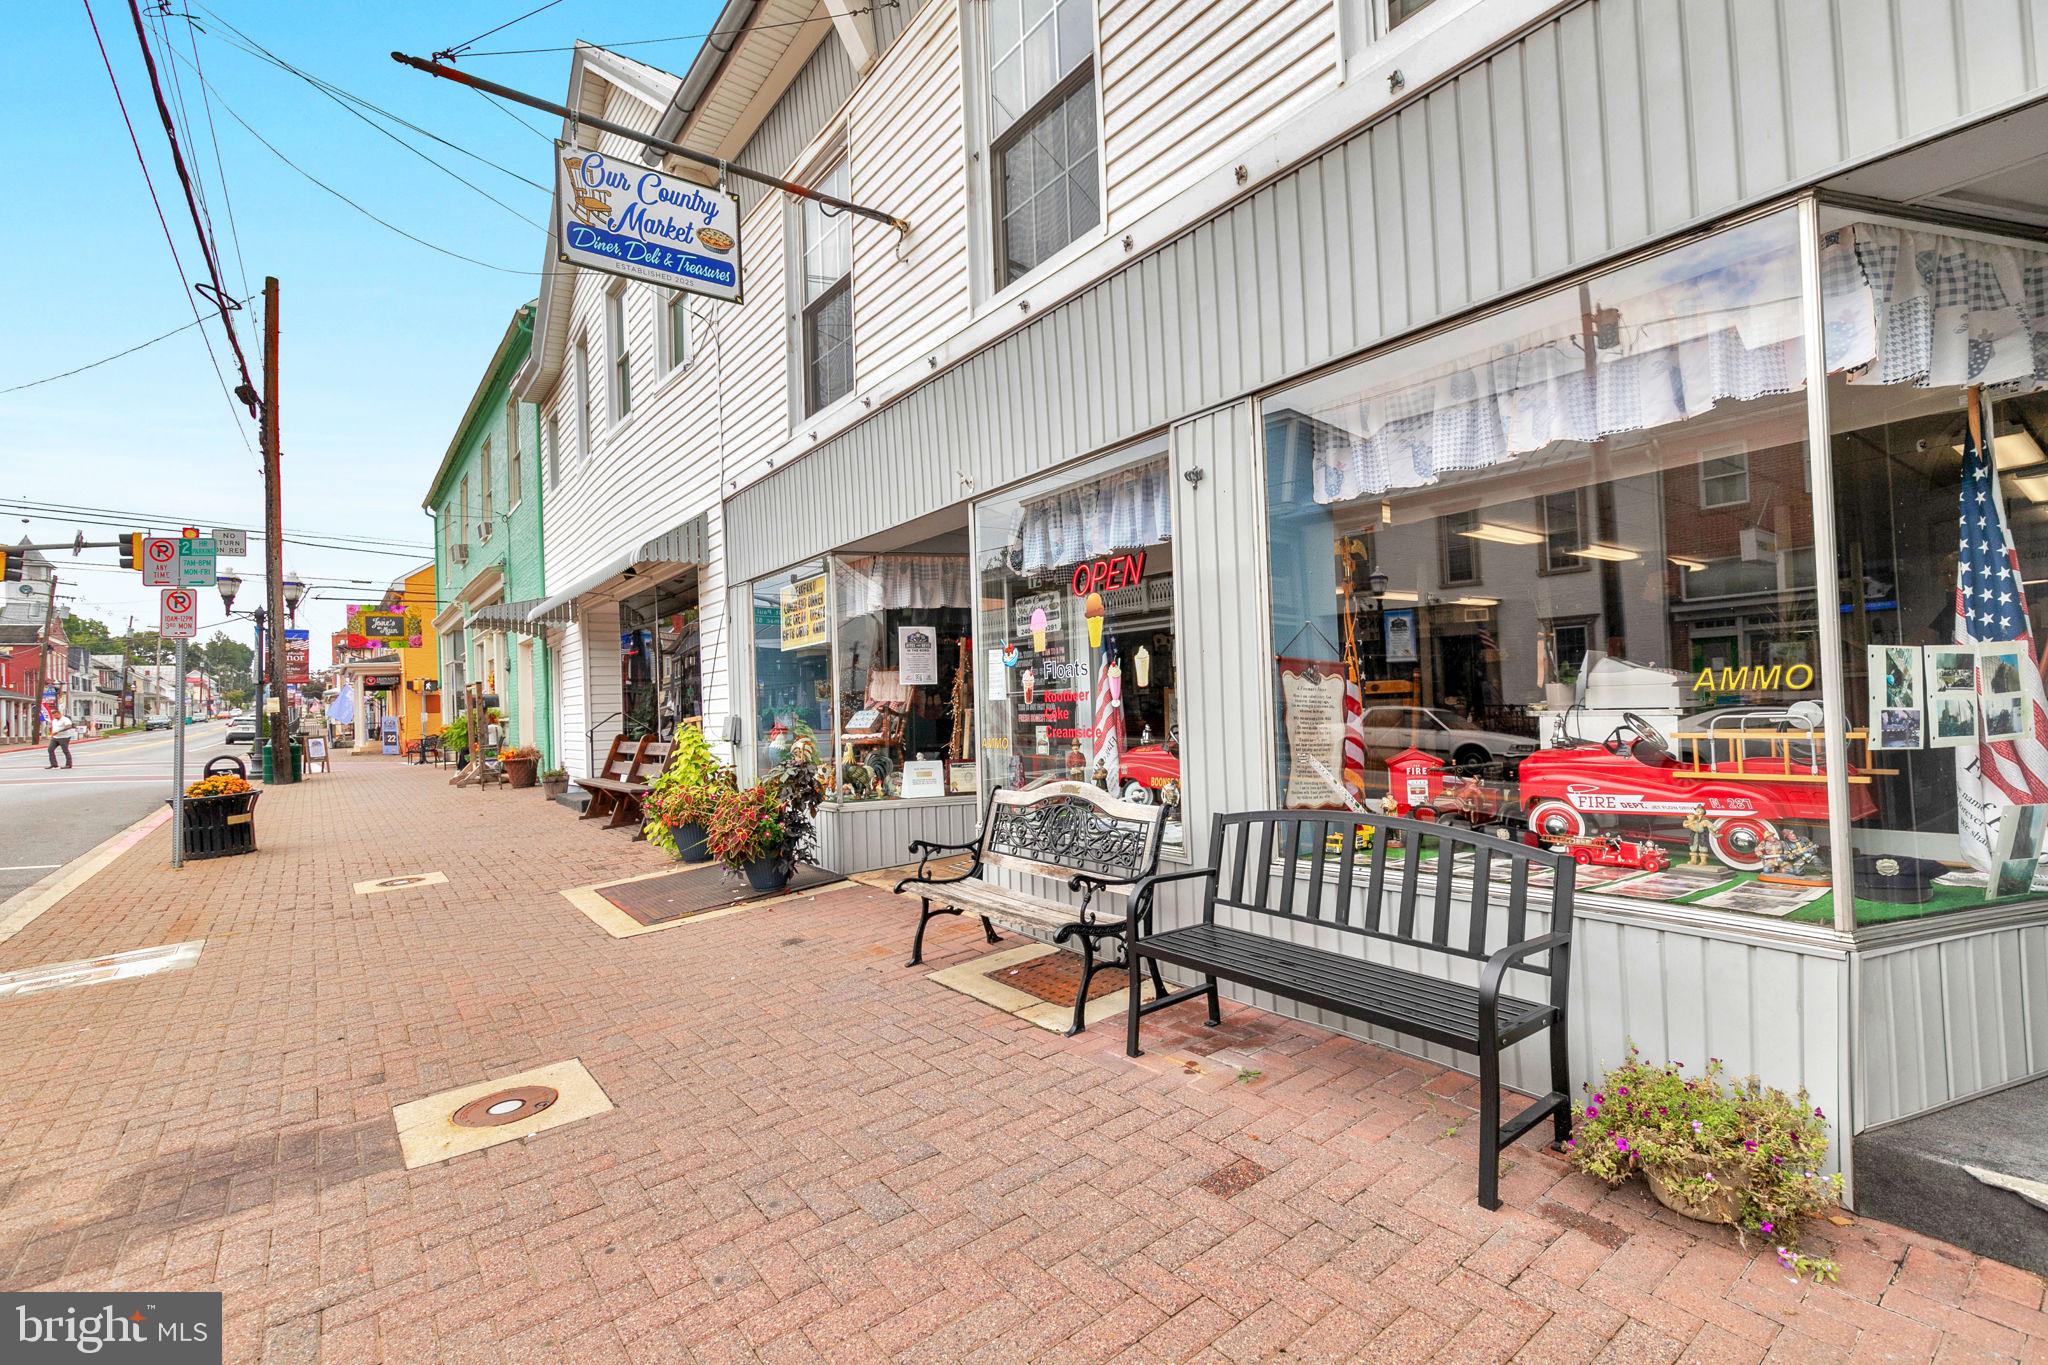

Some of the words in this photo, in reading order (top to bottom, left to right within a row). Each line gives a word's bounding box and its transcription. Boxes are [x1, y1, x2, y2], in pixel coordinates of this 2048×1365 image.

[581, 153, 631, 191] Our
[637, 172, 719, 225] Country
[607, 202, 694, 244] Market
[573, 227, 622, 256] Diner,
[624, 241, 661, 265] Deli
[663, 253, 673, 267] &
[676, 254, 730, 282] Treasures
[615, 262, 672, 281] ESTABLISHED
[675, 277, 695, 287] 2025
[182, 541, 191, 554] 2
[1072, 550, 1145, 596] OPEN
[1043, 659, 1088, 679] Floats
[1692, 663, 1814, 692] AMMO
[1044, 689, 1089, 703] Rootbeer
[1044, 707, 1069, 720] Coke
[1045, 725, 1102, 739] Creamsicle
[982, 738, 1009, 751] AMMO
[1406, 767, 1428, 775] FIRE
[1578, 797, 1616, 809] FIRE
[1727, 798, 1753, 810] 287
